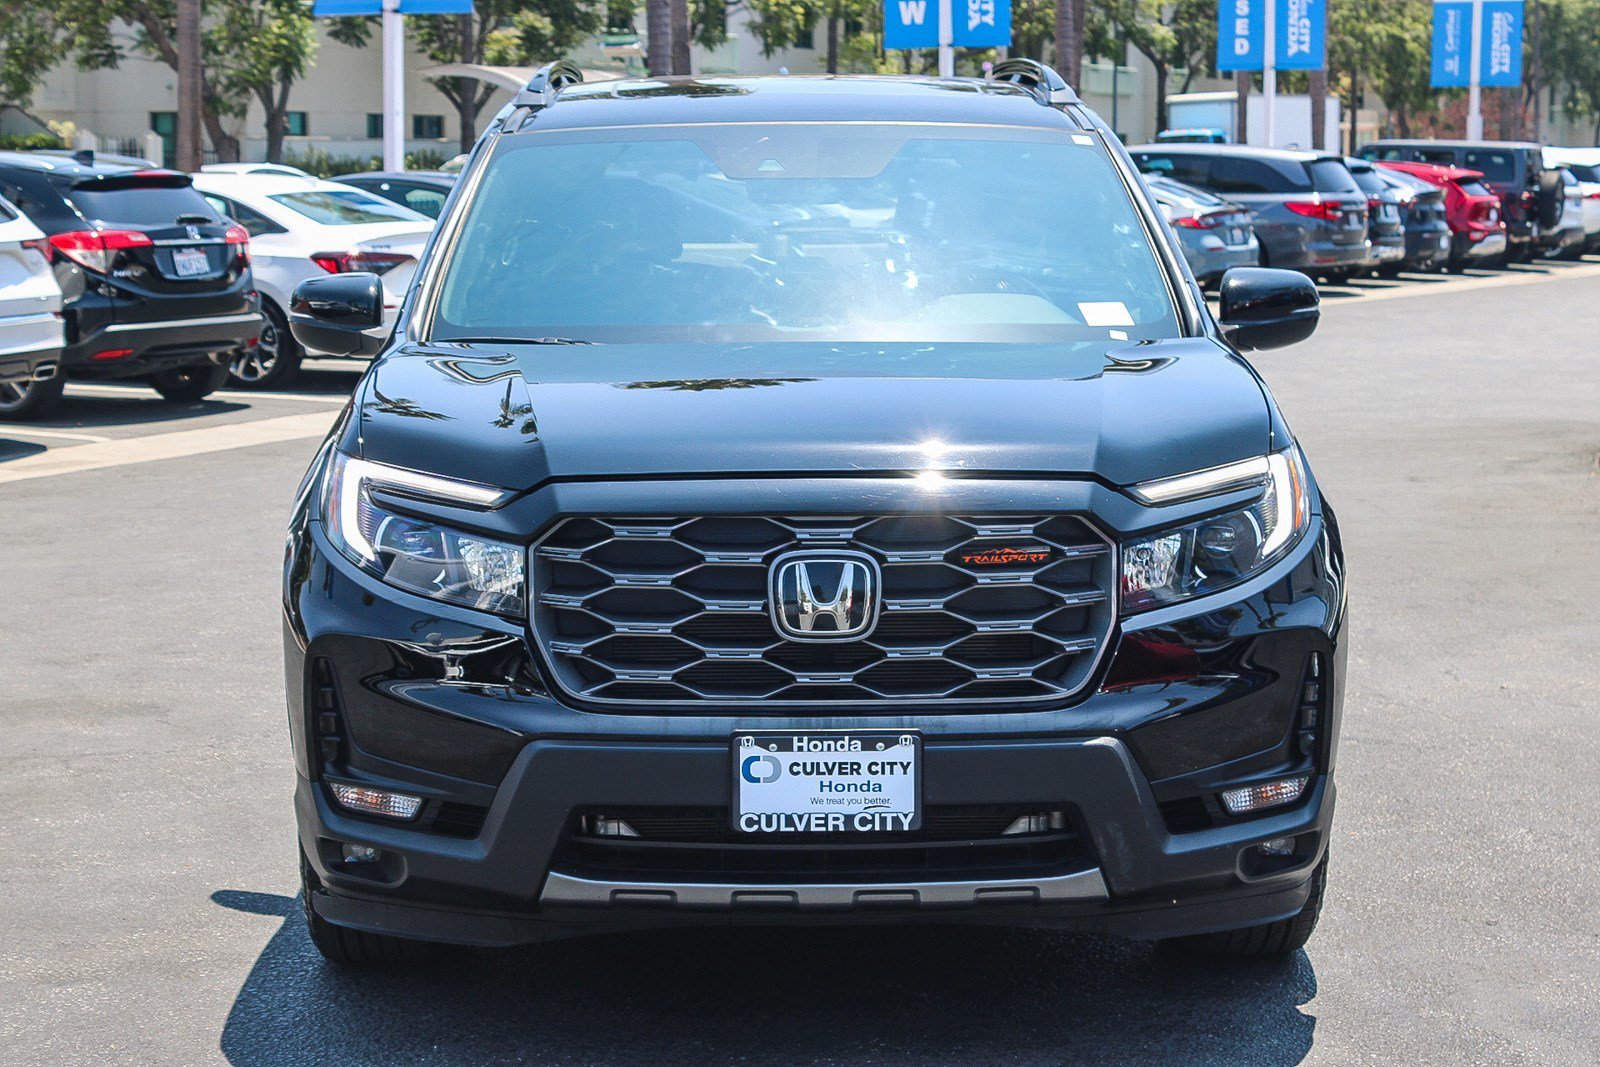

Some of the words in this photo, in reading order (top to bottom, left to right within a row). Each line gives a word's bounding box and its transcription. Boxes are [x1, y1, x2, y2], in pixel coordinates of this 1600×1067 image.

[1234, 0, 1250, 56] SED
[1288, 0, 1299, 57] ONDA
[962, 553, 1048, 565] TRAILSPORT
[792, 736, 862, 752] Honda
[788, 761, 862, 776] CULVER
[866, 761, 912, 776] CITY
[819, 780, 882, 793] Honda
[810, 797, 824, 805] We
[826, 797, 845, 805] treat
[847, 798, 862, 806] you
[863, 796, 892, 805] better.
[739, 812, 845, 832] CULVER
[853, 811, 915, 831] CITY
